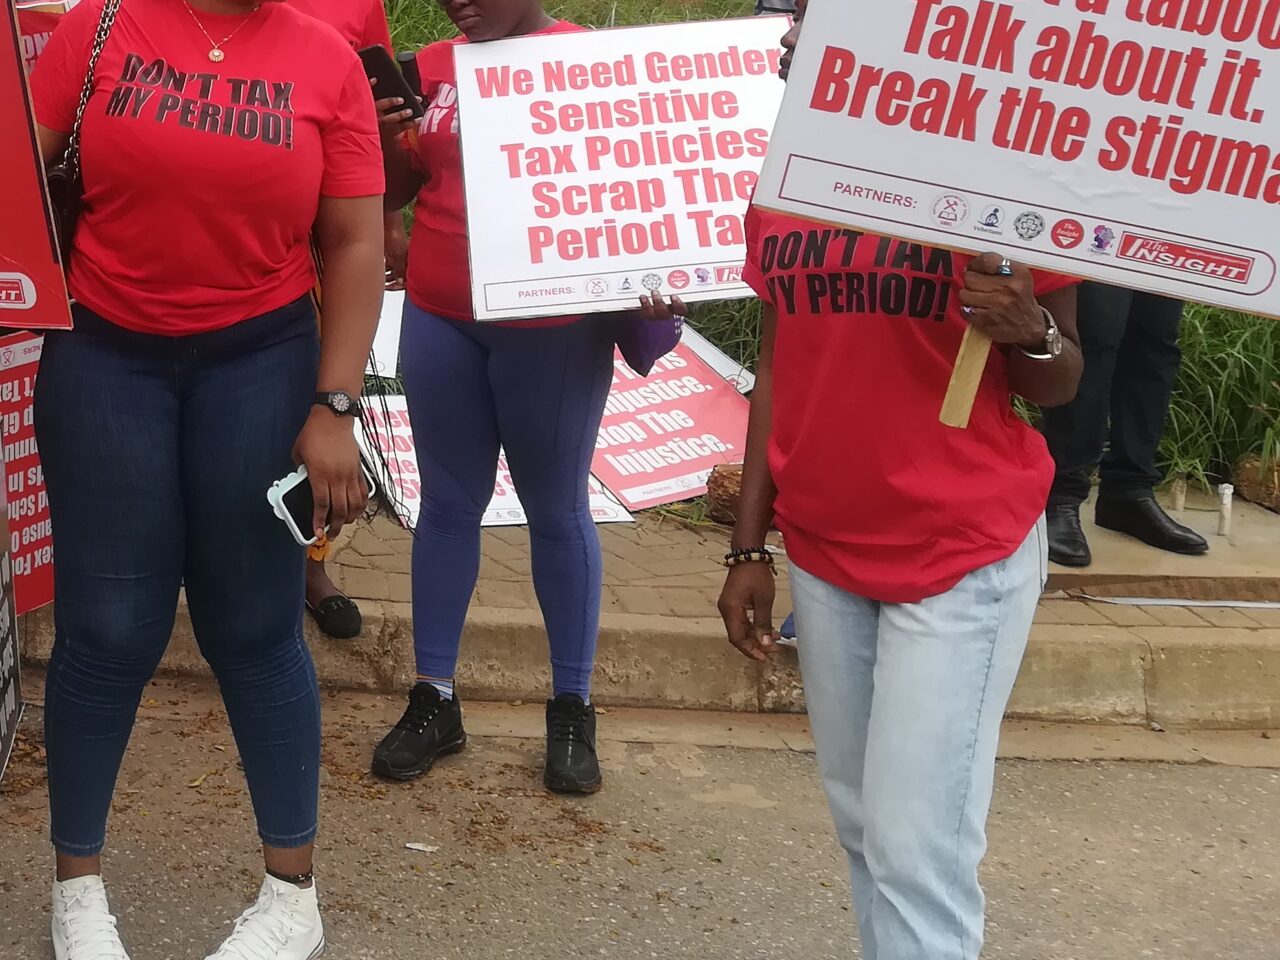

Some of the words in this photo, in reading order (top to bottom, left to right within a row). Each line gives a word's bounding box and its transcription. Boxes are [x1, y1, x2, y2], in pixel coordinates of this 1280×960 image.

[121, 52, 220, 99] DON'T
[227, 78, 295, 114] TAX
[474, 65, 535, 99] We
[542, 54, 638, 93] Need
[644, 45, 783, 84] Gender
[1029, 23, 1207, 110] about
[1208, 45, 1265, 124] it.
[105, 86, 156, 119] MY
[154, 94, 294, 151] PERIOD!
[529, 88, 740, 135] Sensitive
[809, 45, 986, 141] Break
[992, 86, 1092, 162] the
[500, 142, 577, 179] Tax
[584, 126, 769, 171] Policies
[532, 175, 666, 219] Scrap
[673, 167, 758, 205] The
[833, 181, 918, 209] PARTNERS:
[527, 213, 681, 264] Period
[687, 210, 745, 247] Ta
[761, 229, 864, 275] DON'T
[1126, 237, 1246, 278] INSIGHT
[1142, 239, 1169, 253] The
[518, 285, 576, 299] PARTNERS:
[806, 272, 951, 322] PERIOD!
[605, 375, 714, 416] njustice.
[635, 409, 695, 436] The
[604, 433, 735, 477] Injustice.
